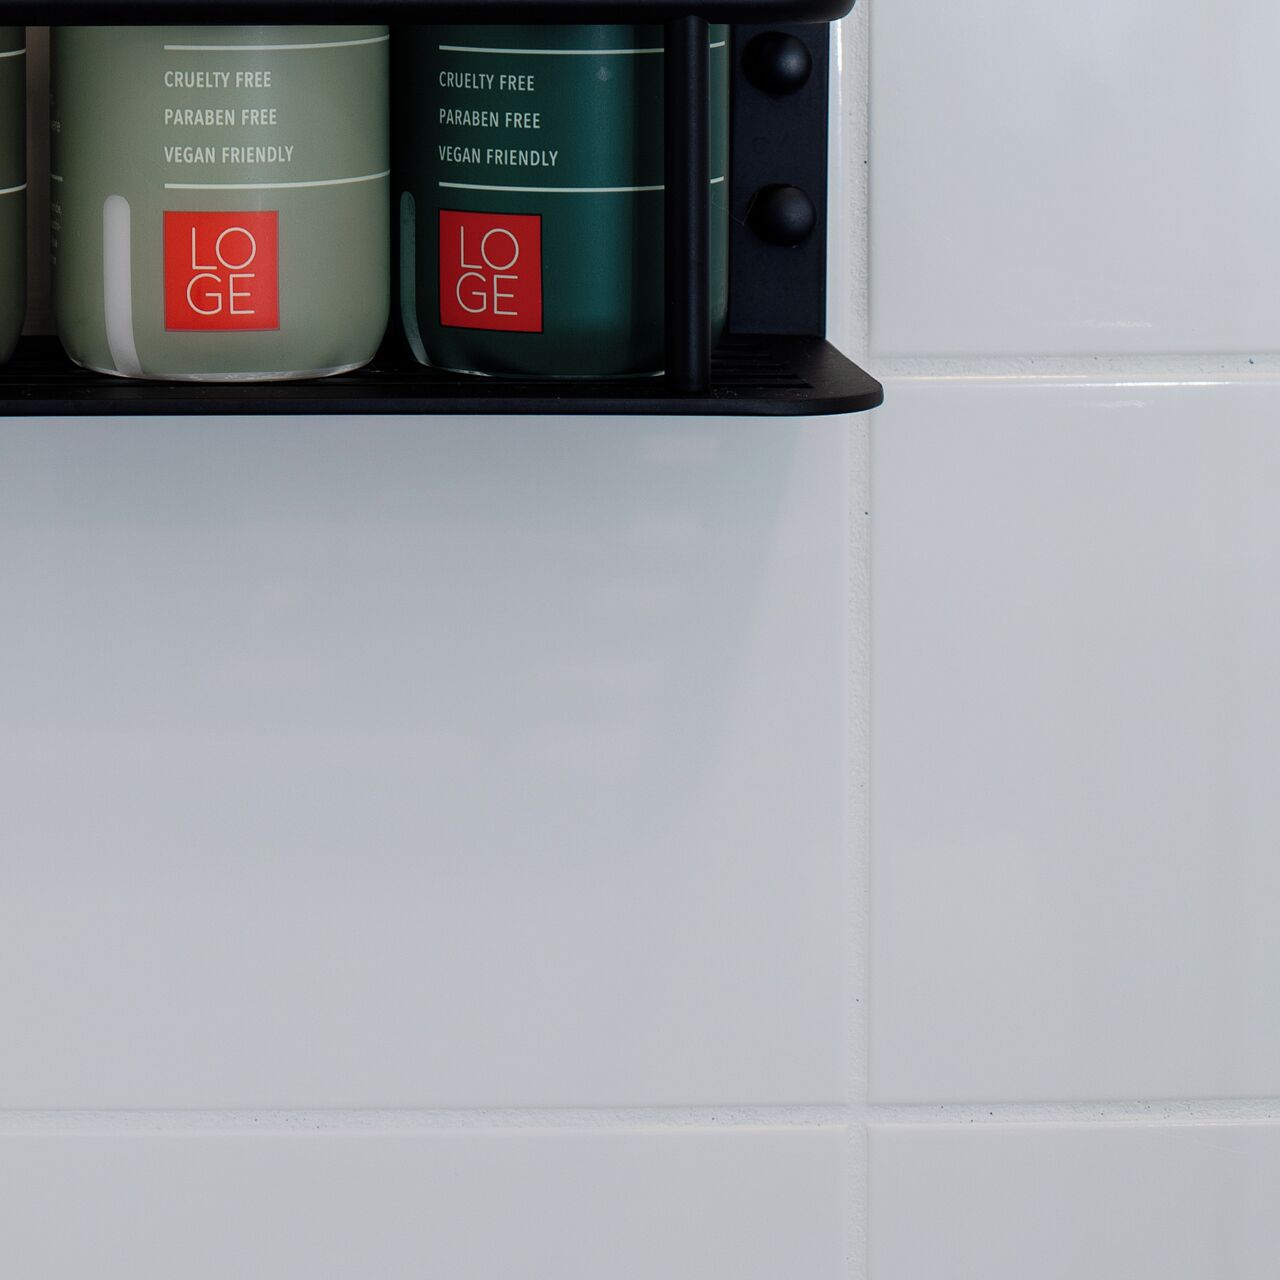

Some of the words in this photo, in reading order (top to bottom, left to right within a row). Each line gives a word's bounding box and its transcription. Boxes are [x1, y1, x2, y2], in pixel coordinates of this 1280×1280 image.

[164, 71, 231, 88] CRUELTY
[235, 71, 272, 88] FREE
[439, 71, 495, 90] CRUELTY
[499, 74, 535, 91] FREE
[164, 108, 235, 126] PARABEN
[241, 108, 277, 126] FREE
[439, 108, 499, 128] PARABEN
[505, 112, 541, 129] FREE
[164, 146, 216, 164] VEGAN
[222, 145, 294, 164] FRIENDLY
[438, 145, 481, 164] VEGAN
[486, 148, 558, 167] FRIENDLY
[191, 227, 257, 270] LO
[460, 226, 520, 271] LO
[186, 272, 256, 316] GE
[456, 271, 519, 316] GE
